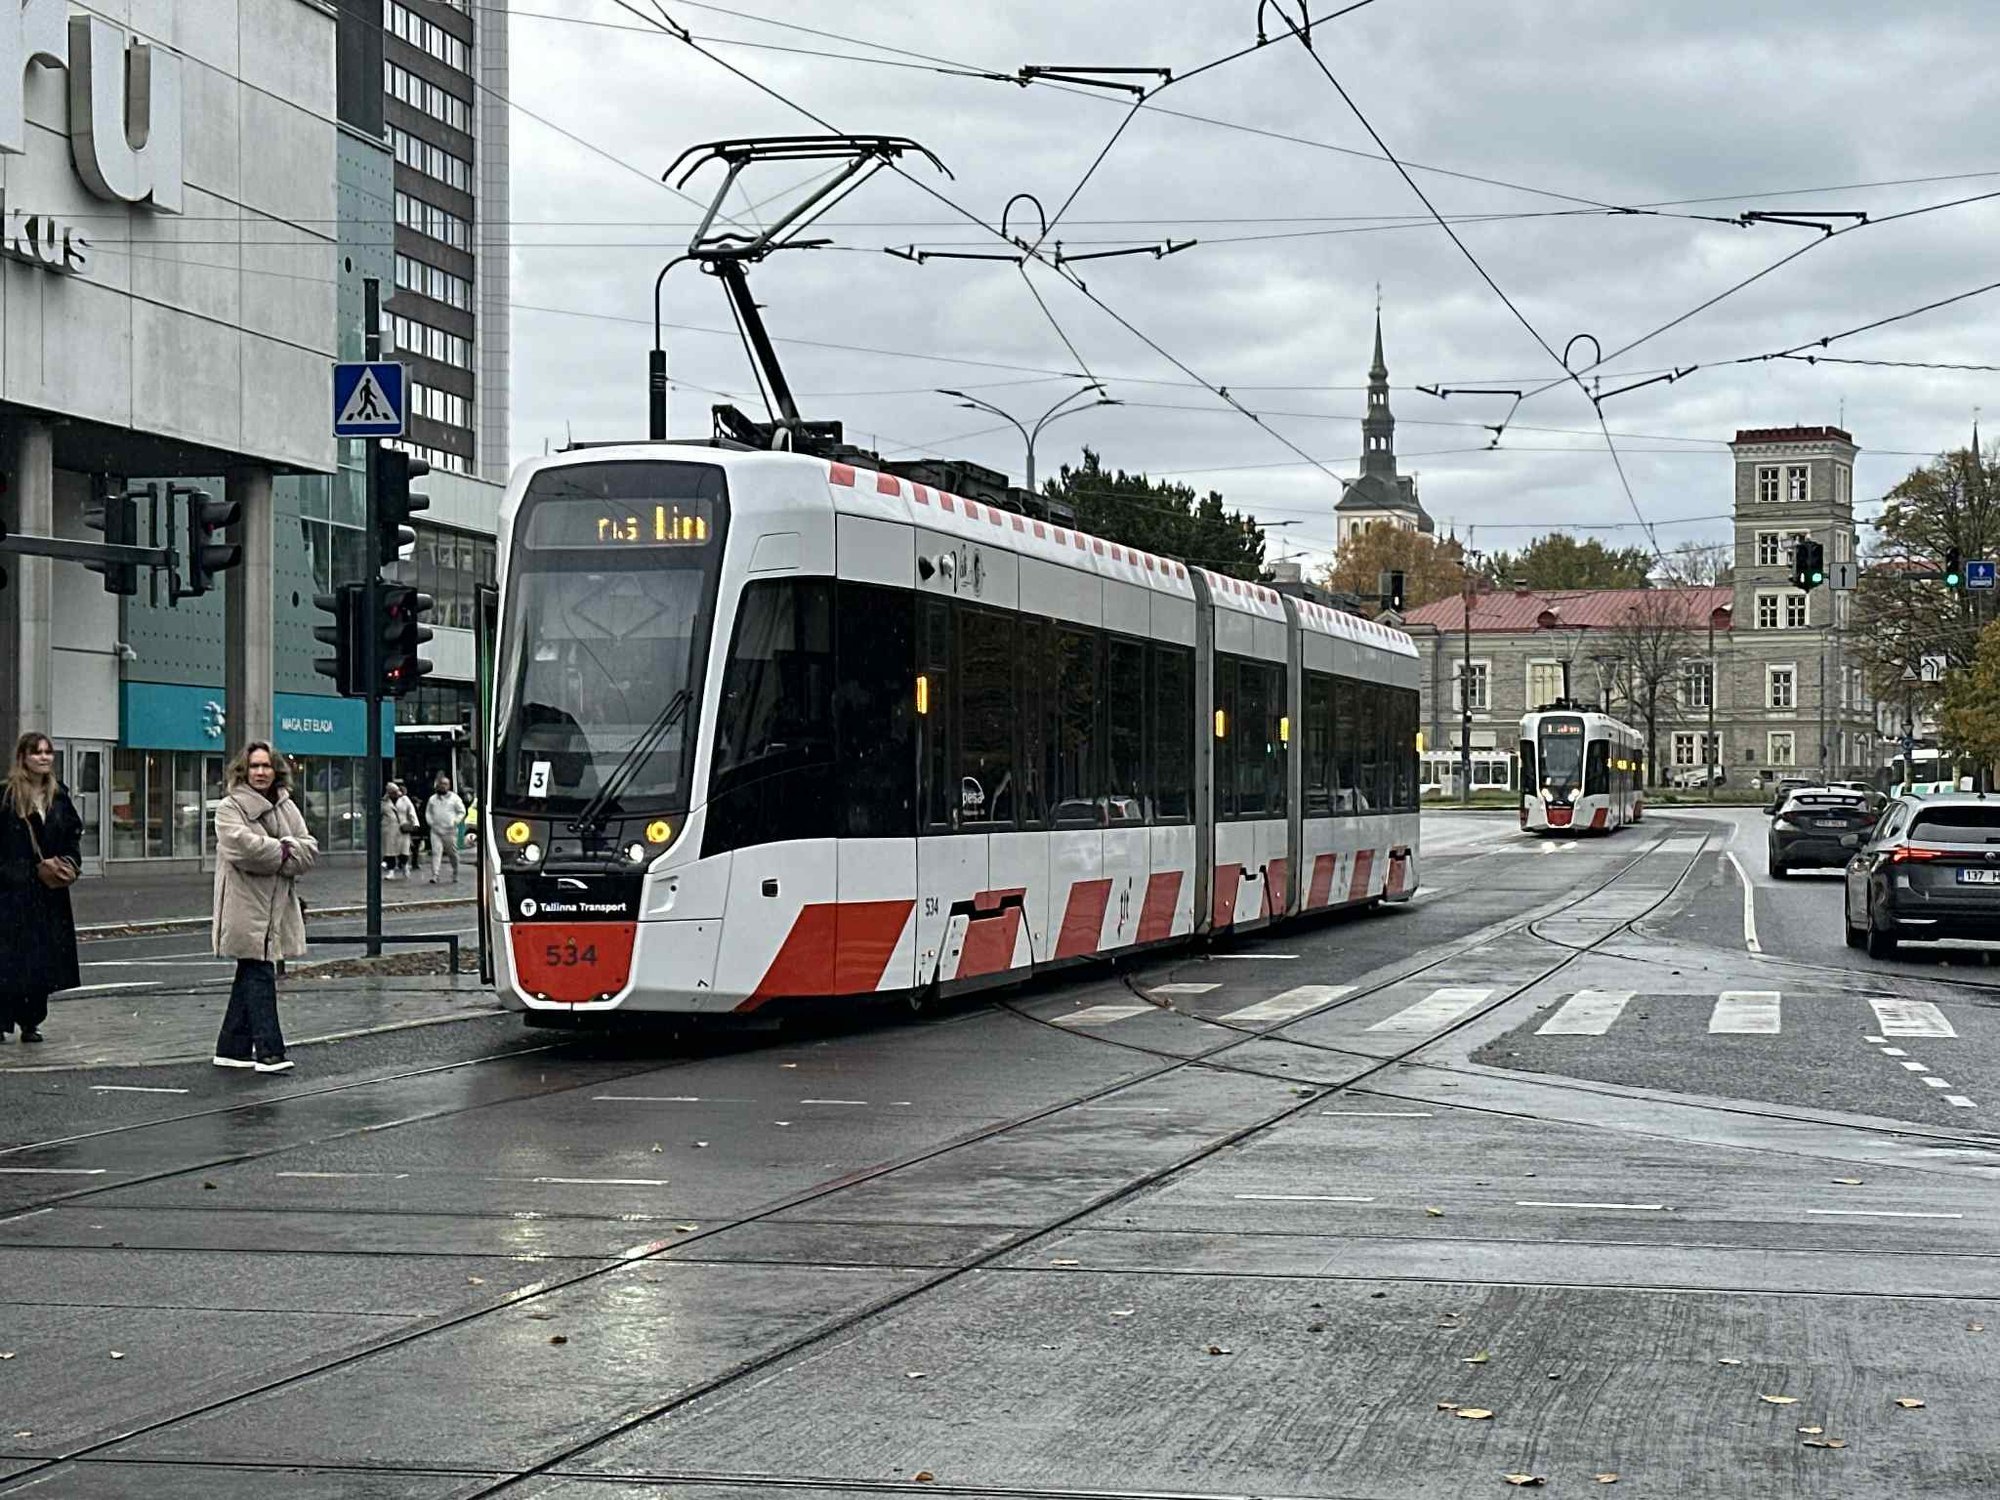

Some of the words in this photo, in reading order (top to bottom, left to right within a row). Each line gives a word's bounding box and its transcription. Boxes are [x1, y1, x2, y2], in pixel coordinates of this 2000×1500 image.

[533, 771, 545, 788] 3
[1966, 870, 1985, 881] 137
[540, 902, 577, 912] Tallinna
[579, 902, 627, 914] Transport
[925, 897, 939, 916] 534
[546, 944, 597, 967] 534
